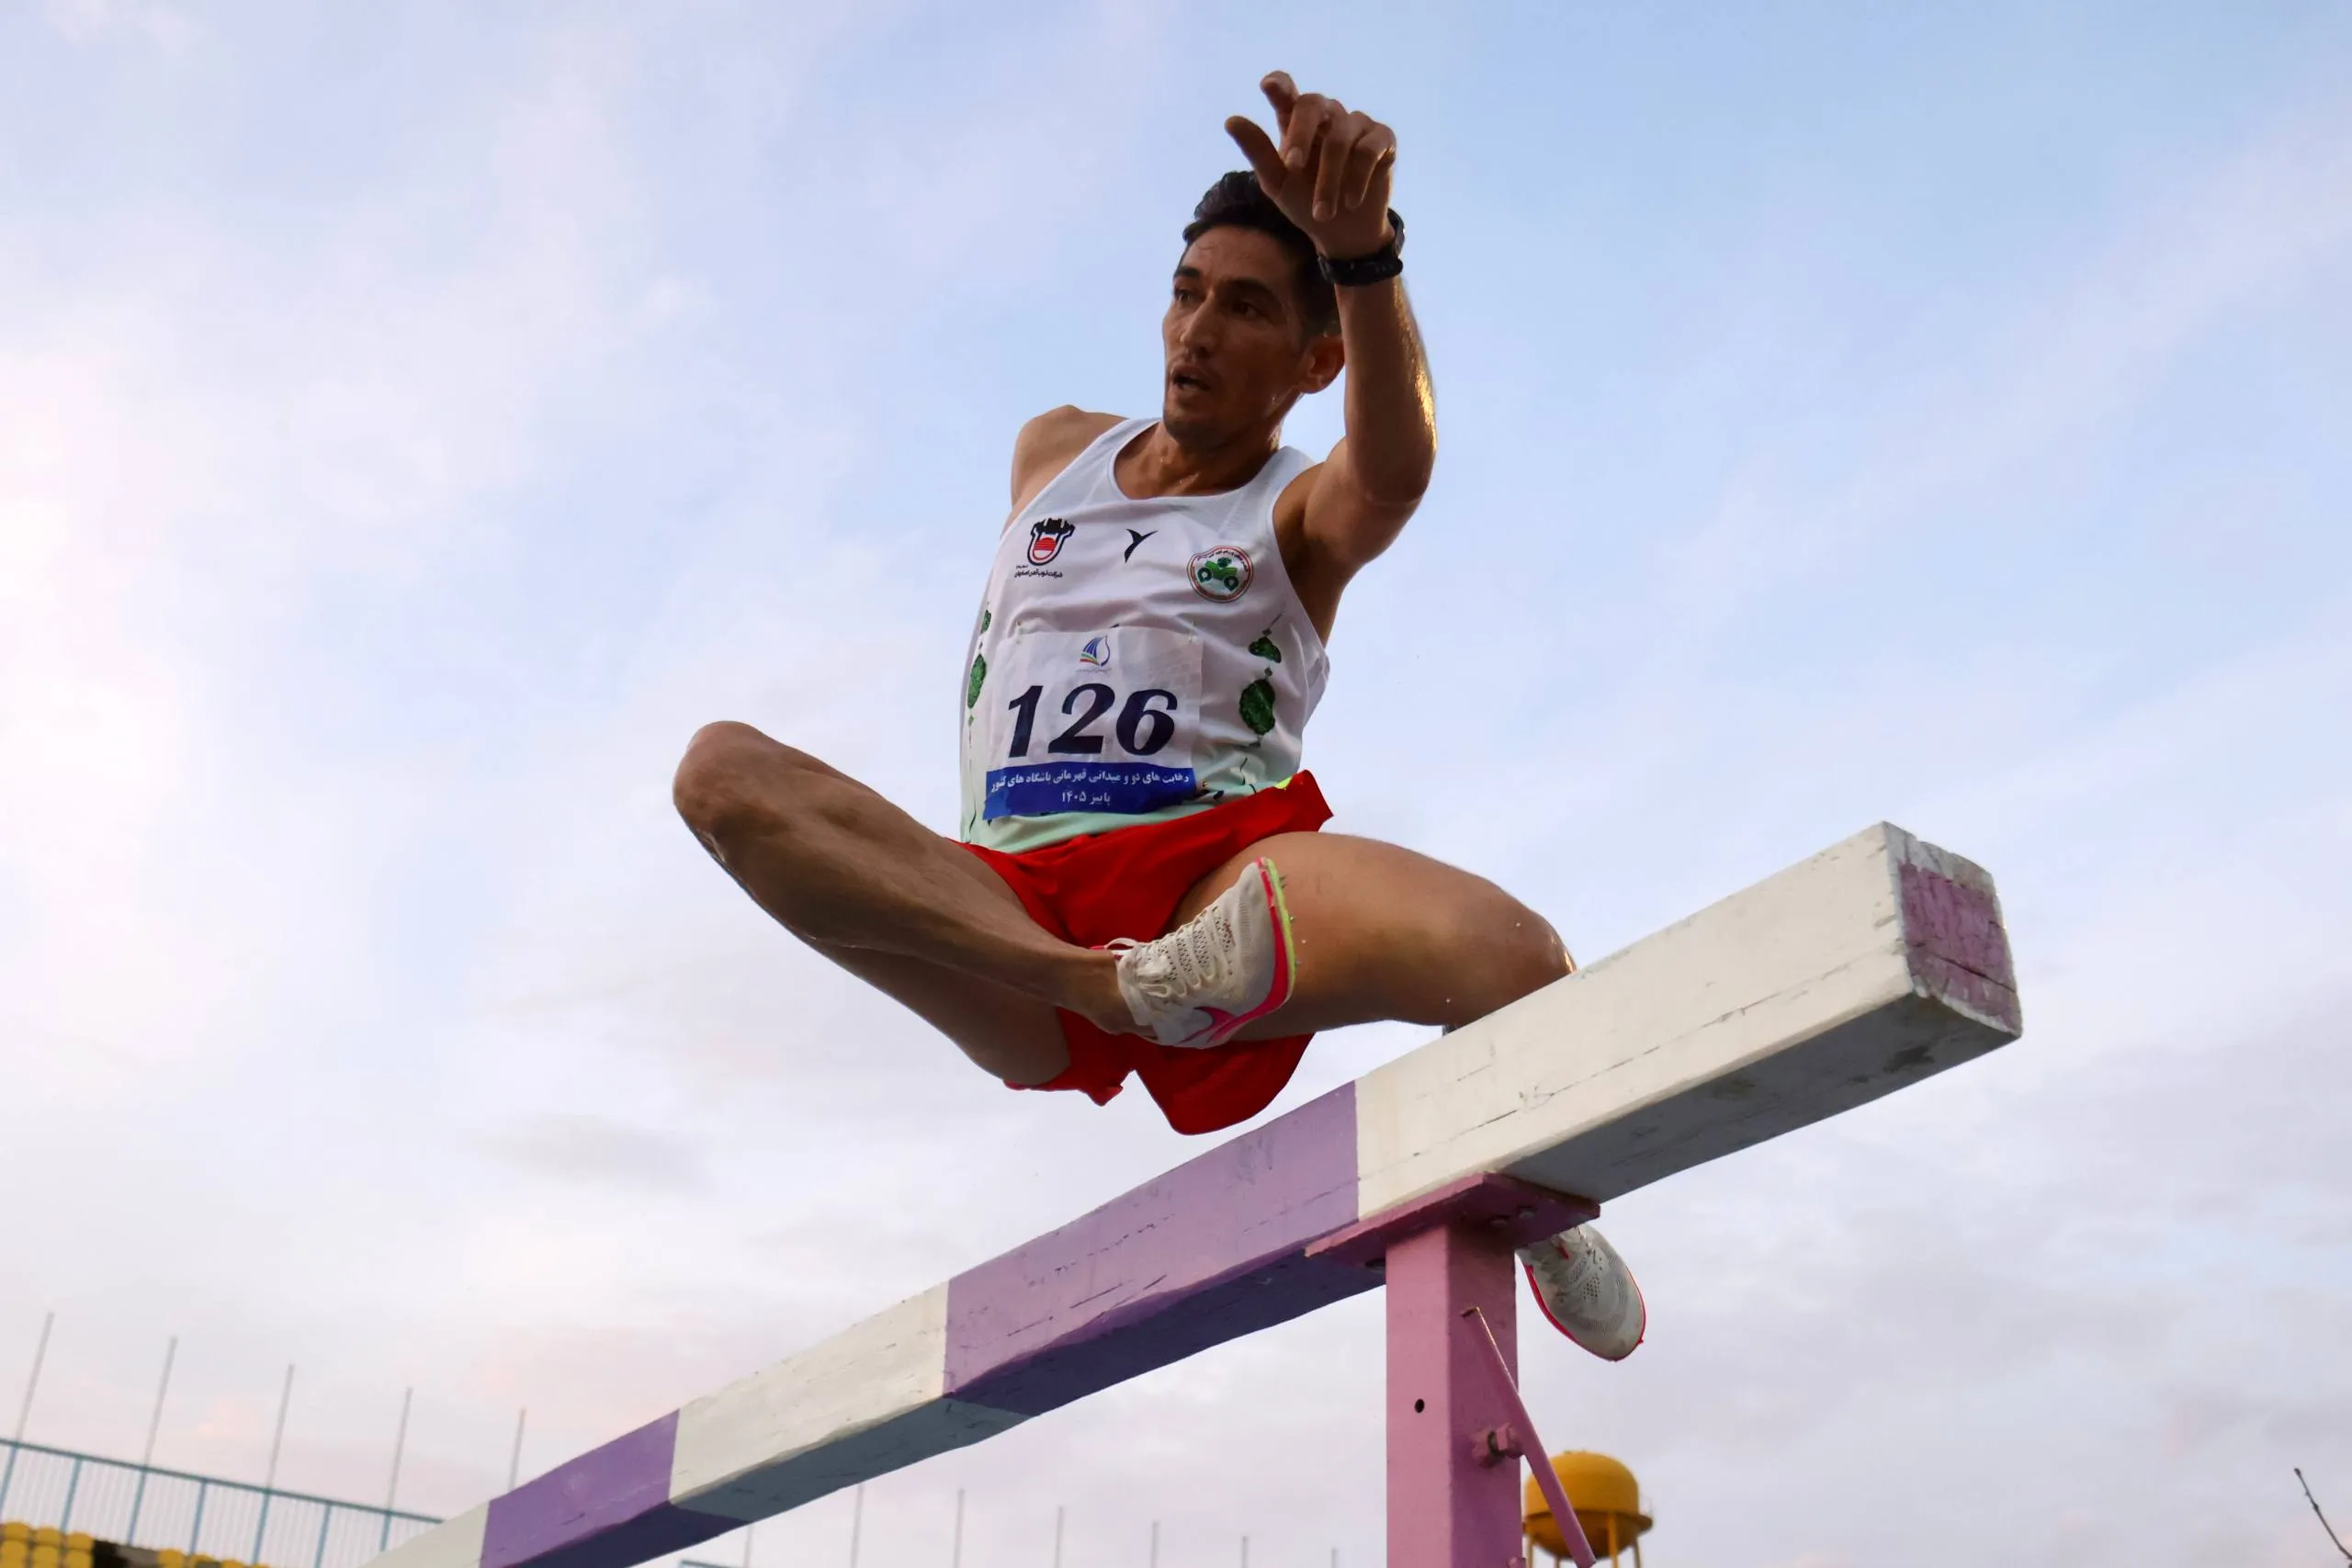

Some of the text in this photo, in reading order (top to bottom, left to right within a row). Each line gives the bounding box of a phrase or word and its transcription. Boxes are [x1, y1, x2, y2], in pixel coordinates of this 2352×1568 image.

[1008, 682, 1178, 758] 126
[1007, 773, 1024, 787] های
[1025, 772, 1051, 784] باشگاه
[1053, 769, 1087, 784] قهرمانی
[1089, 770, 1121, 784] میدانی
[1123, 774, 1129, 785] و
[1131, 773, 1140, 785] دو
[1142, 771, 1160, 784] های
[1061, 790, 1087, 803] ۱۴۰۵
